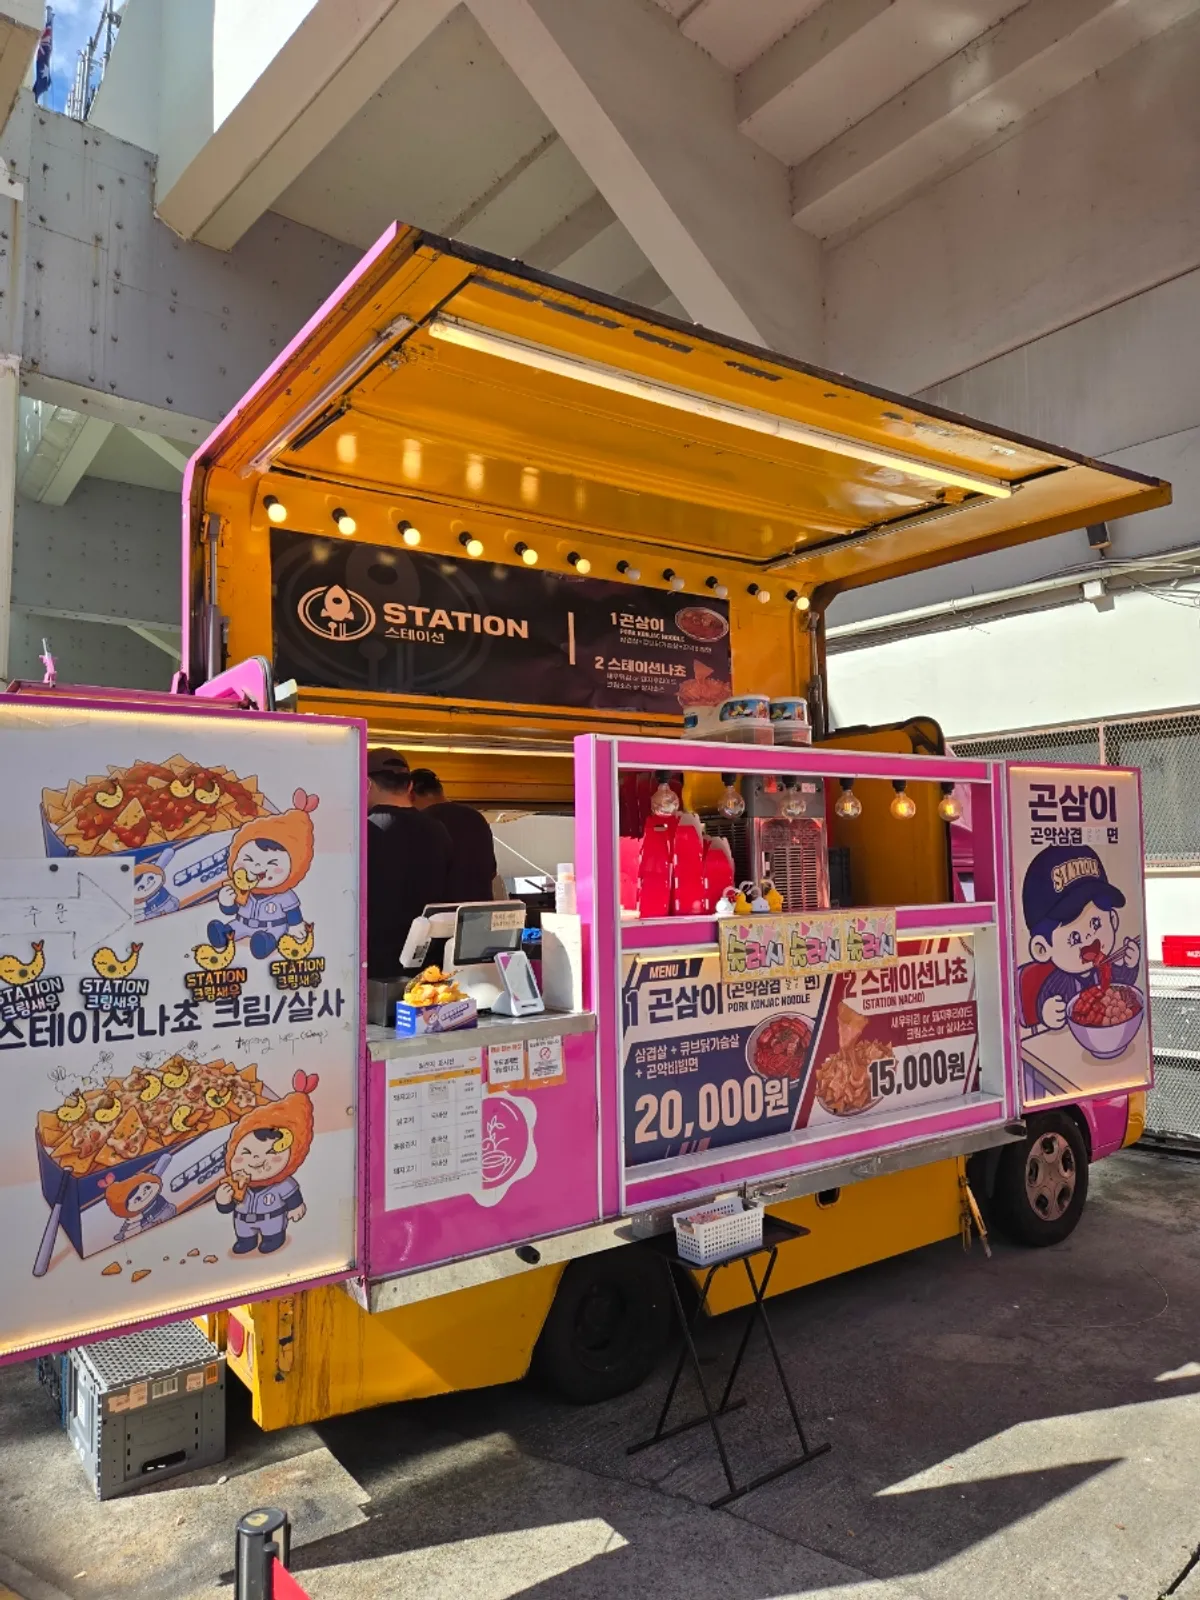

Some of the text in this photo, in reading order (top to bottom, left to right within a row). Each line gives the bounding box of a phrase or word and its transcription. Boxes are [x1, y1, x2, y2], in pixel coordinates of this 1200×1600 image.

[383, 602, 529, 639] STATION
[619, 613, 665, 632] 곤삼이
[595, 656, 604, 669] 2
[1028, 783, 1118, 823] 곤삼이
[271, 958, 324, 975] STATION
[649, 959, 691, 979] MENU 1
[82, 979, 148, 994] STATION
[186, 969, 246, 988] STATION
[845, 956, 968, 998] 2 스테이션나쵸
[212, 988, 346, 1029] 크림/살사
[627, 982, 724, 1027] 1 곤삼이
[728, 993, 811, 1013] PORK KONJAC NOODLE
[863, 997, 898, 1011] (STATION
[923, 1014, 931, 1025] or
[937, 1025, 945, 1035] or
[635, 1045, 667, 1064] 삼겹살
[680, 1034, 740, 1055] 큐브닭가슴살
[646, 1057, 699, 1080] 곤약비빔면
[869, 1049, 966, 1097] 15,000원
[634, 1075, 790, 1145] 20,000원
